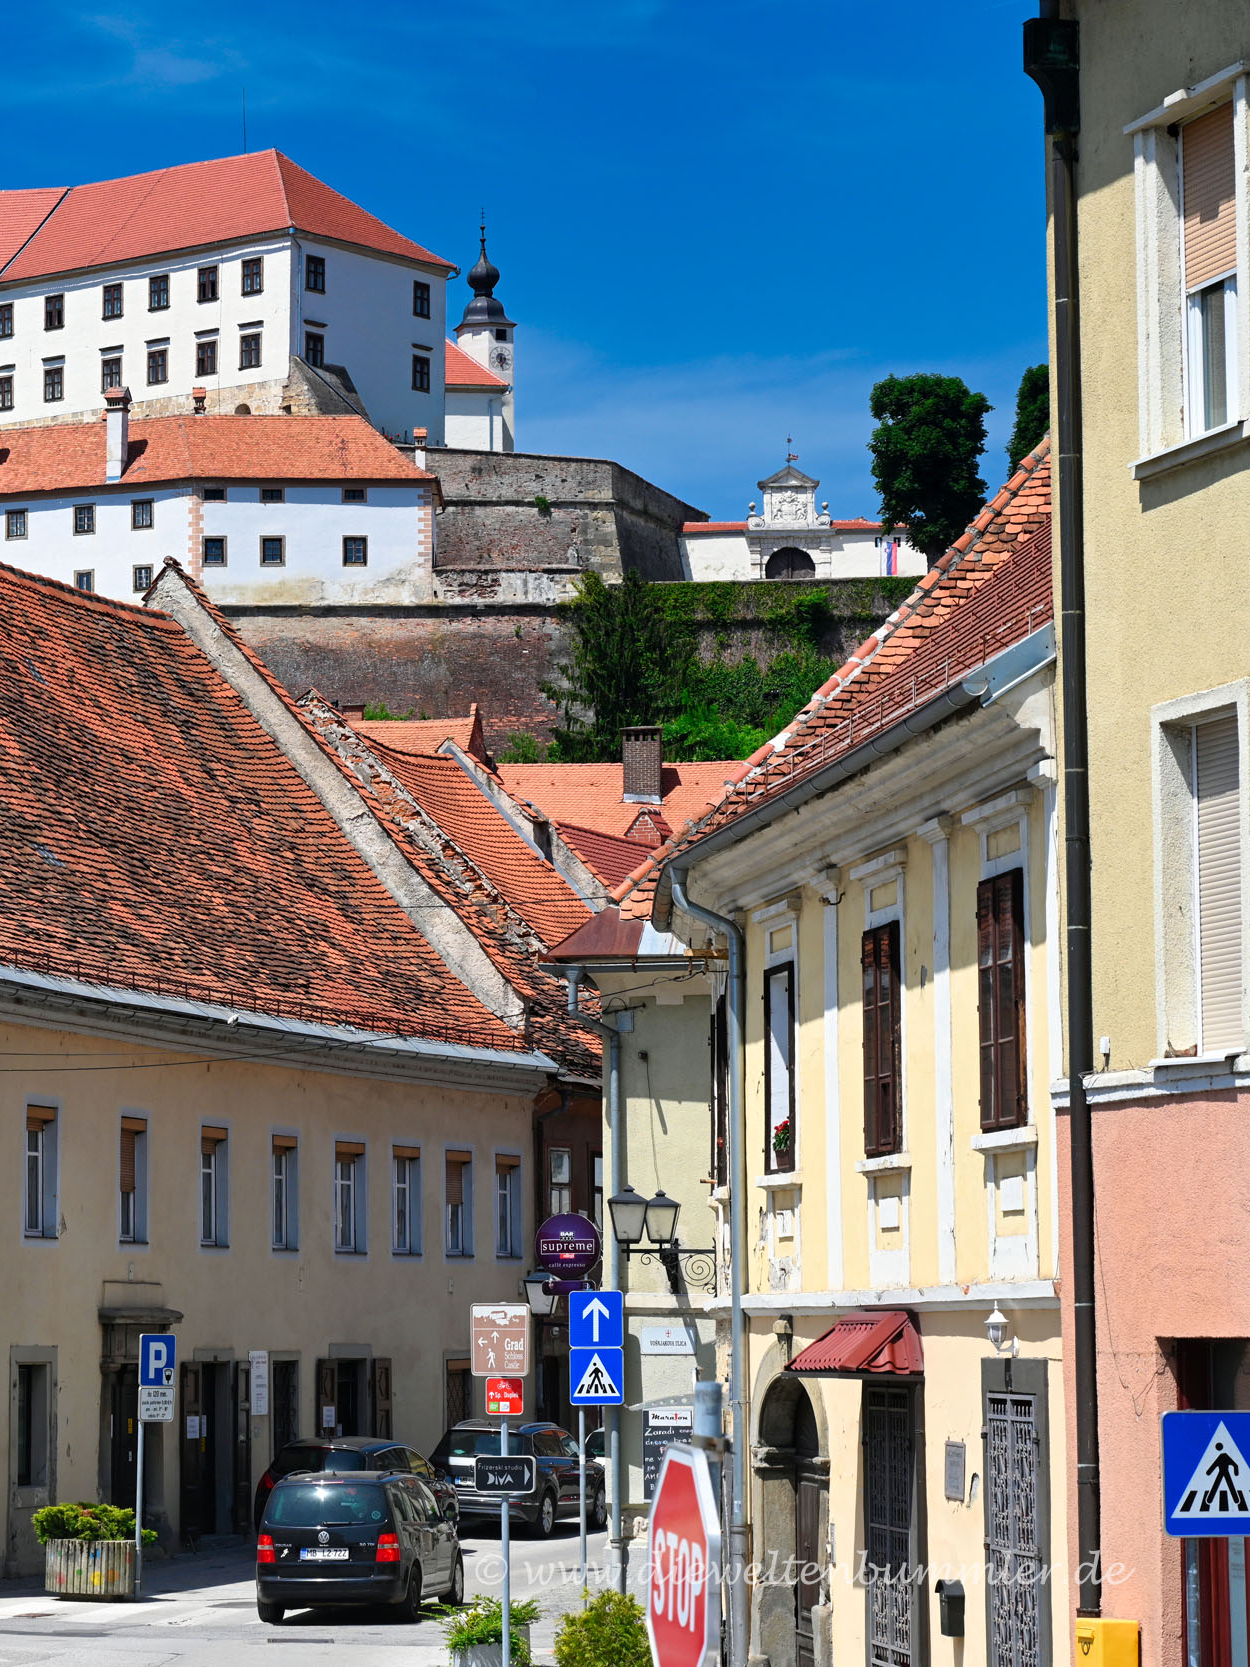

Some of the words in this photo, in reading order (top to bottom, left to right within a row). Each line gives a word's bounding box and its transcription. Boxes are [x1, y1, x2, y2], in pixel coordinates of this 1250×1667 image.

[542, 1242, 593, 1251] supreme
[504, 1338, 524, 1351] Grad
[148, 1341, 167, 1379] P
[653, 1527, 705, 1632] STOP
